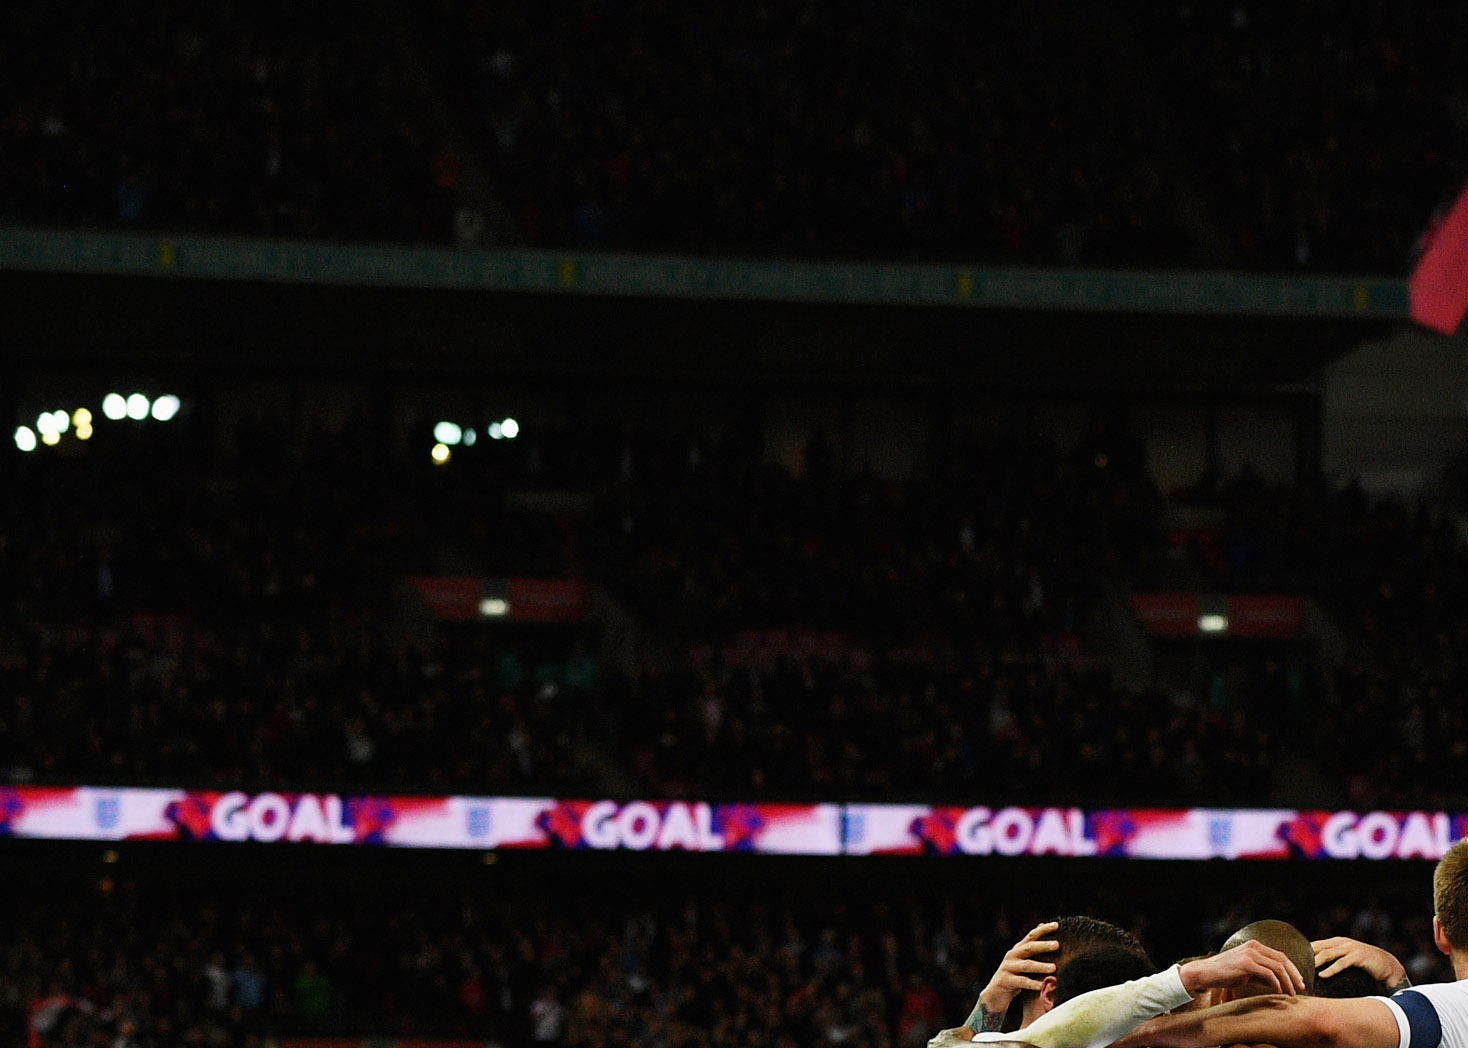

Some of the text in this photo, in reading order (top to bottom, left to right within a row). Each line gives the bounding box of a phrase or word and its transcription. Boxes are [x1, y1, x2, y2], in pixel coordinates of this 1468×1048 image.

[211, 793, 354, 842] GOAL
[582, 802, 723, 850] GOAL
[955, 808, 1097, 856] GOAL
[1321, 812, 1453, 858] GOAL
